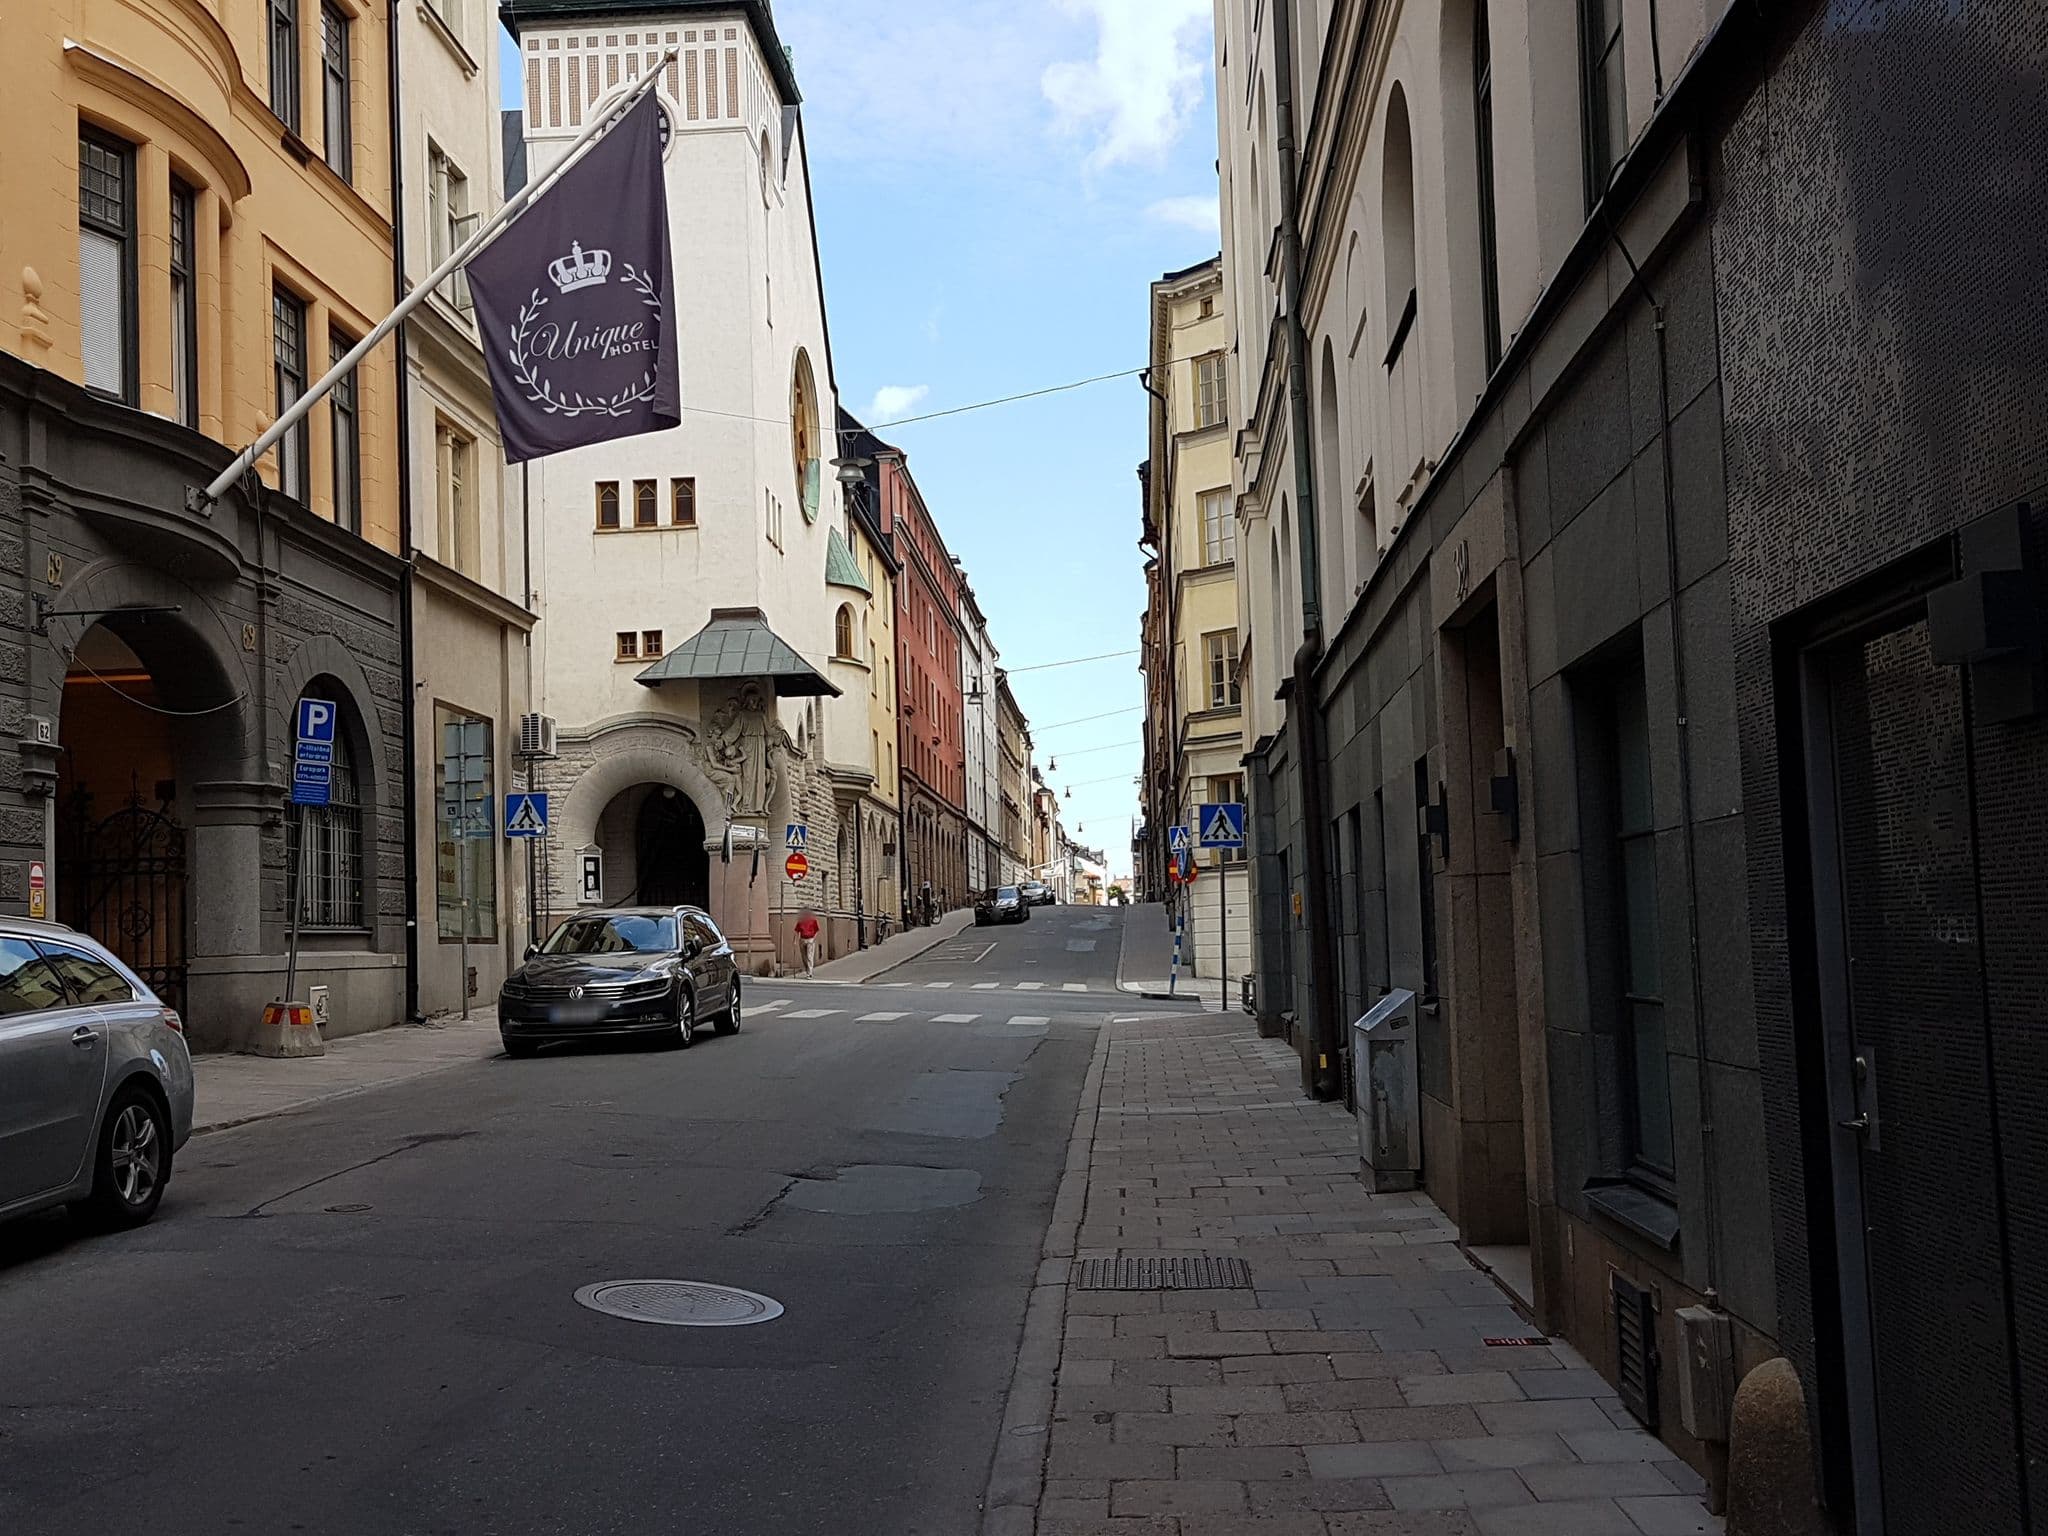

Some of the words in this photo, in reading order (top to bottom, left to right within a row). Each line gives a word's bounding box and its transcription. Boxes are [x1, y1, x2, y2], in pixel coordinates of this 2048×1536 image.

[530, 320, 644, 360] Unique
[611, 340, 659, 357] HOTEL
[40, 724, 49, 739] 62
[307, 704, 329, 736] P
